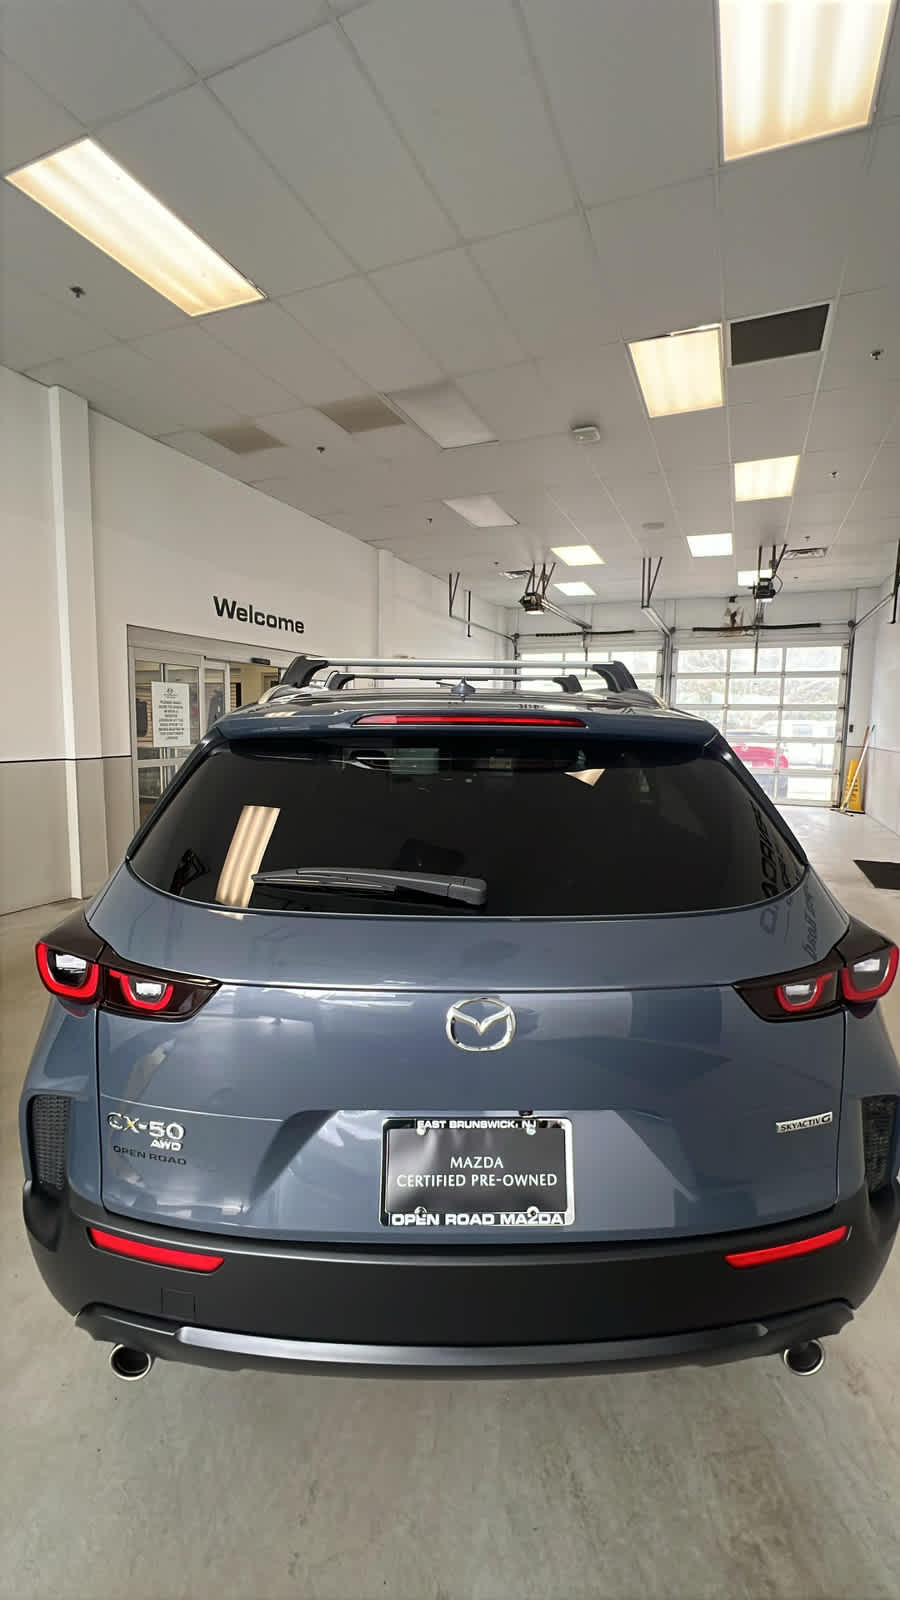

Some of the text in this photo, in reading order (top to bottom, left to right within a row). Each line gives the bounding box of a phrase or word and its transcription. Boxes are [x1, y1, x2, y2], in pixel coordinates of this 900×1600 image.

[213, 595, 305, 634] Welcome
[107, 1112, 184, 1140] CX-50
[417, 1120, 446, 1129] EAST
[522, 1120, 537, 1129] NJ
[150, 1139, 182, 1151] AWD
[113, 1145, 187, 1165] OPEN ROAD
[450, 1156, 504, 1169] MAZDA
[396, 1174, 557, 1188] CERTIFIED PRE-OWNED
[391, 1213, 440, 1226] OPEN
[445, 1213, 495, 1226] ROAD
